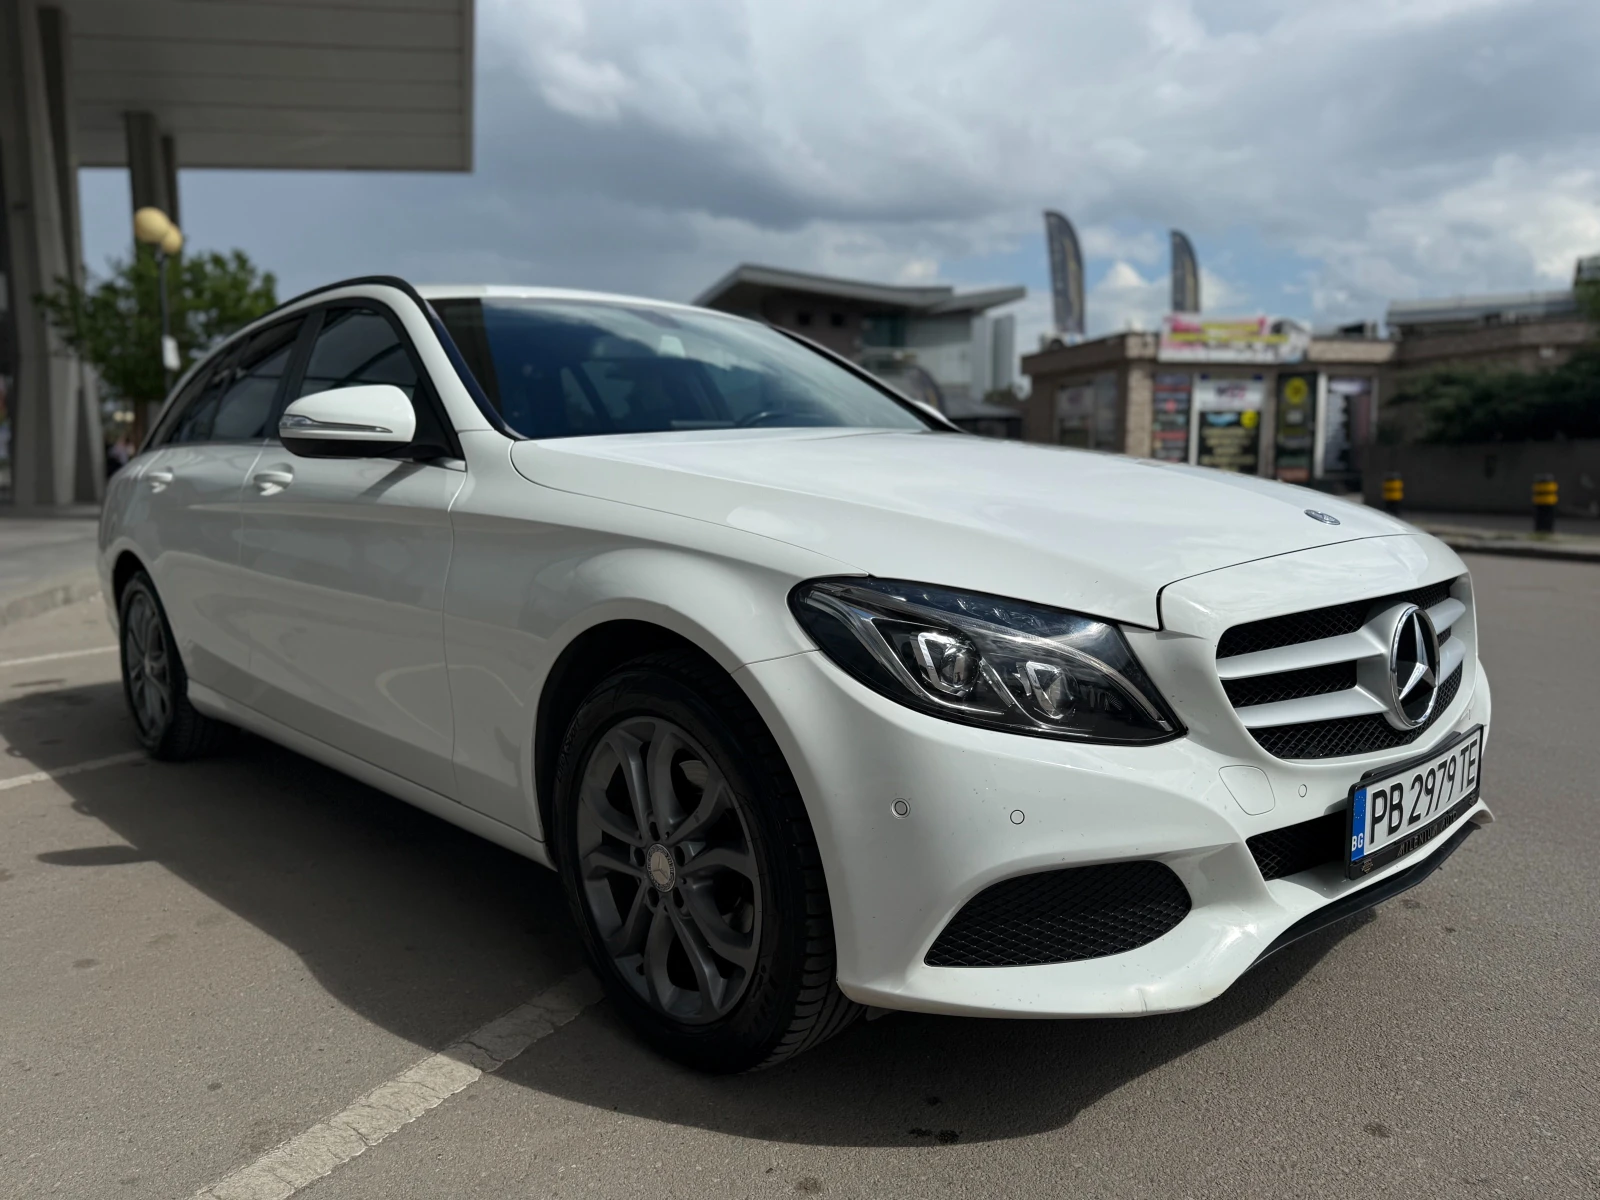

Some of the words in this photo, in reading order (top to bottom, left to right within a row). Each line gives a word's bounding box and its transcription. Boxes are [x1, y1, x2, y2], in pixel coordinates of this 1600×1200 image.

[1369, 782, 1404, 845] PB
[1407, 754, 1457, 827] 2979
[1459, 738, 1478, 793] TE
[1351, 832, 1364, 852] BG
